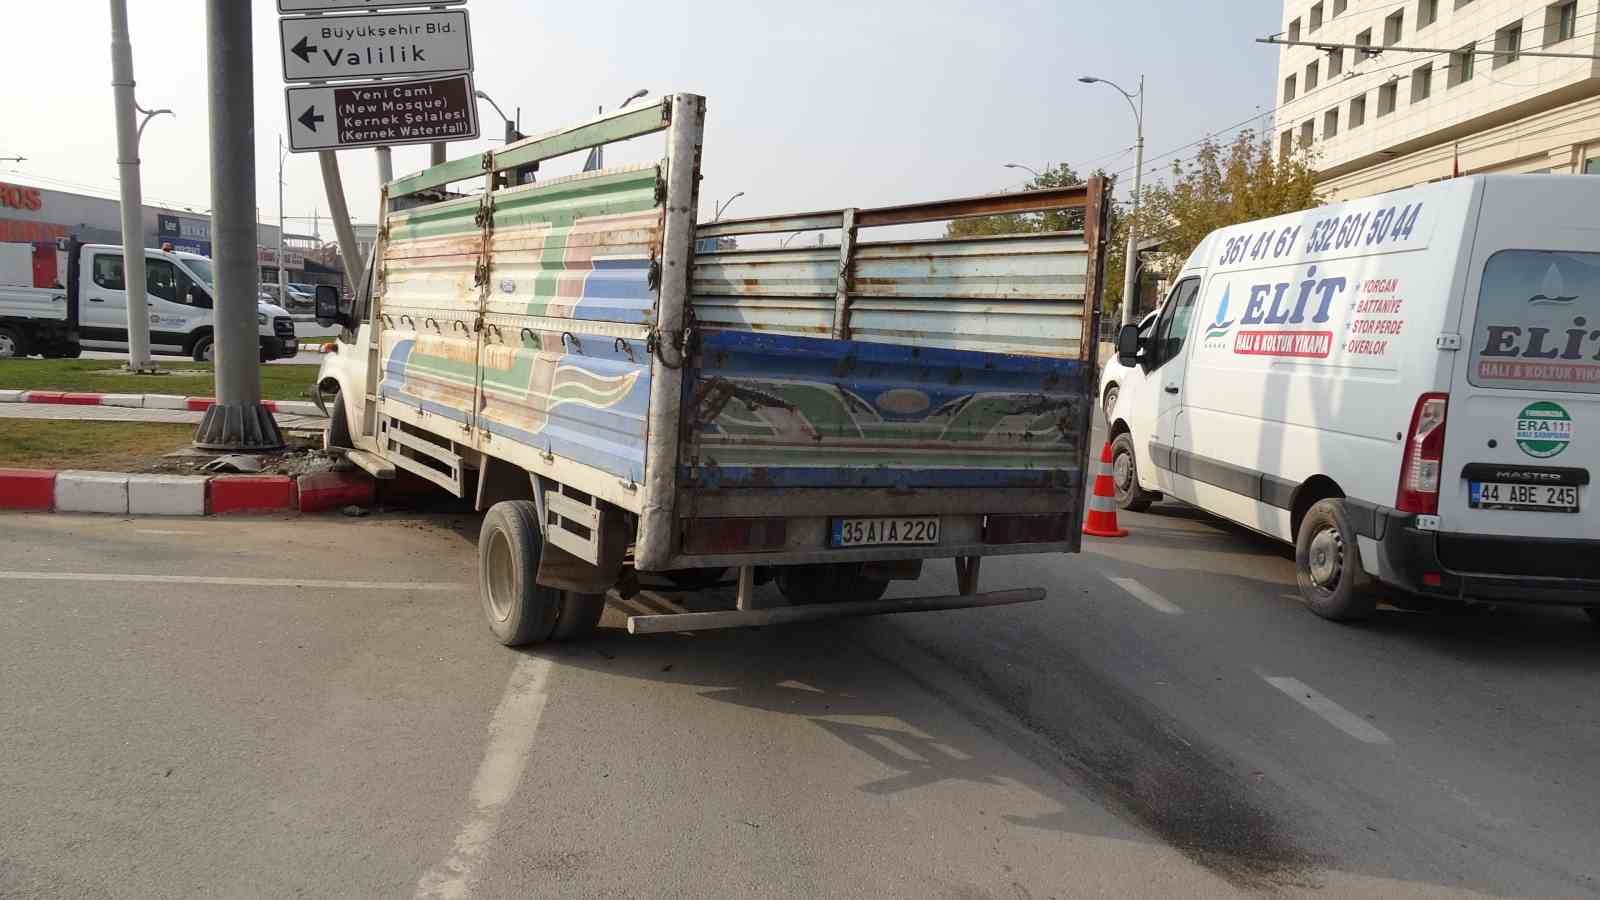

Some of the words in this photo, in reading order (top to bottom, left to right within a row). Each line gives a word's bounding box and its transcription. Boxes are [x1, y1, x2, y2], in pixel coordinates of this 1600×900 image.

[426, 22, 456, 34] Bld.
[323, 44, 426, 67] Valilik
[352, 89, 388, 101] Yeni
[393, 86, 433, 98] Cami
[338, 103, 377, 116] (New
[382, 96, 447, 112] Mosque)
[344, 114, 399, 127] Kernek
[404, 109, 465, 124] Şelalesi
[341, 128, 396, 142] (Kernek
[400, 122, 469, 136] Waterfall)
[1219, 234, 1252, 266] 361
[1250, 229, 1276, 261] 41
[1273, 225, 1302, 258] 61
[1306, 217, 1340, 254] 532
[1335, 211, 1371, 250] 601
[1366, 206, 1396, 246] 50
[1391, 202, 1423, 241] 44
[1240, 265, 1347, 325] ELİT
[1363, 279, 1399, 293] YORGAN
[1357, 296, 1403, 313] BATTANİYE
[1236, 335, 1254, 350] HALI
[1261, 335, 1294, 352] KOLTUK
[1294, 335, 1329, 353] YIKAMA
[1348, 339, 1387, 355] OVERLOK
[1481, 363, 1510, 377] HALI
[1523, 366, 1570, 379] KOLTUK
[1518, 420, 1550, 431] ERA
[1496, 471, 1560, 480] MASTER
[1481, 485, 1499, 501] 44
[1510, 486, 1537, 503] ABE
[1547, 487, 1575, 505] 245
[843, 521, 863, 543] 35
[902, 521, 937, 541] 220
